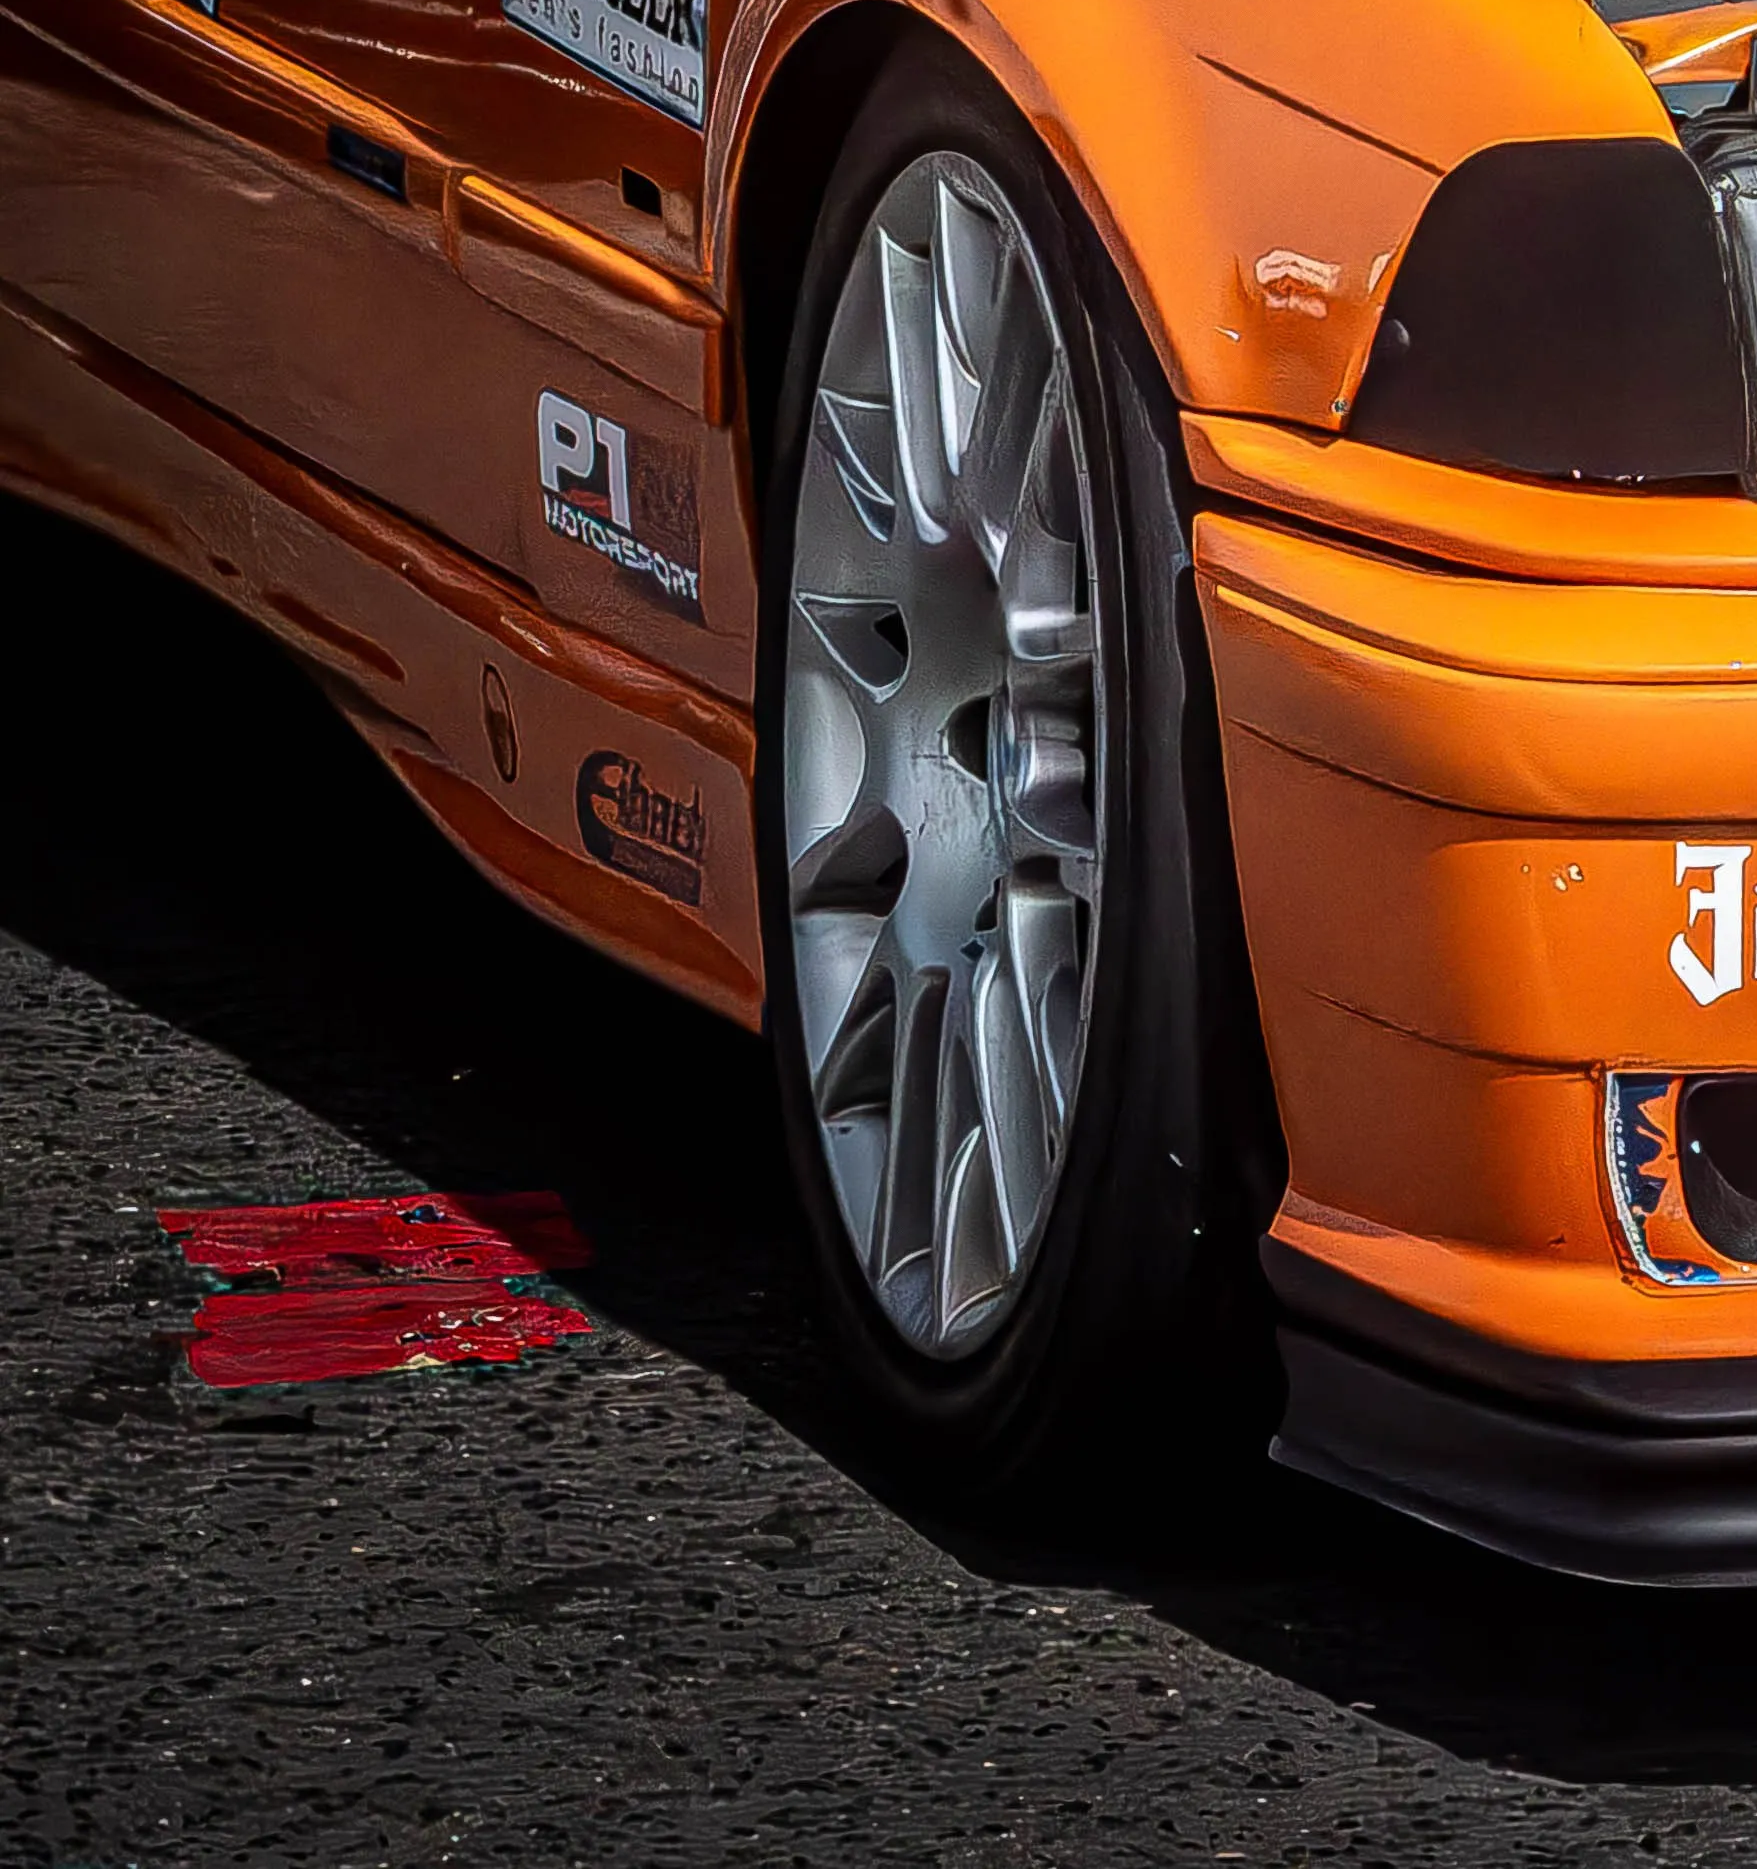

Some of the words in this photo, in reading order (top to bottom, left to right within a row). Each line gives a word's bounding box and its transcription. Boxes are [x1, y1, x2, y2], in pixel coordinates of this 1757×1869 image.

[598, 16, 700, 108] fashion
[538, 390, 632, 531] P1
[543, 492, 699, 601] MOTORSPORT
